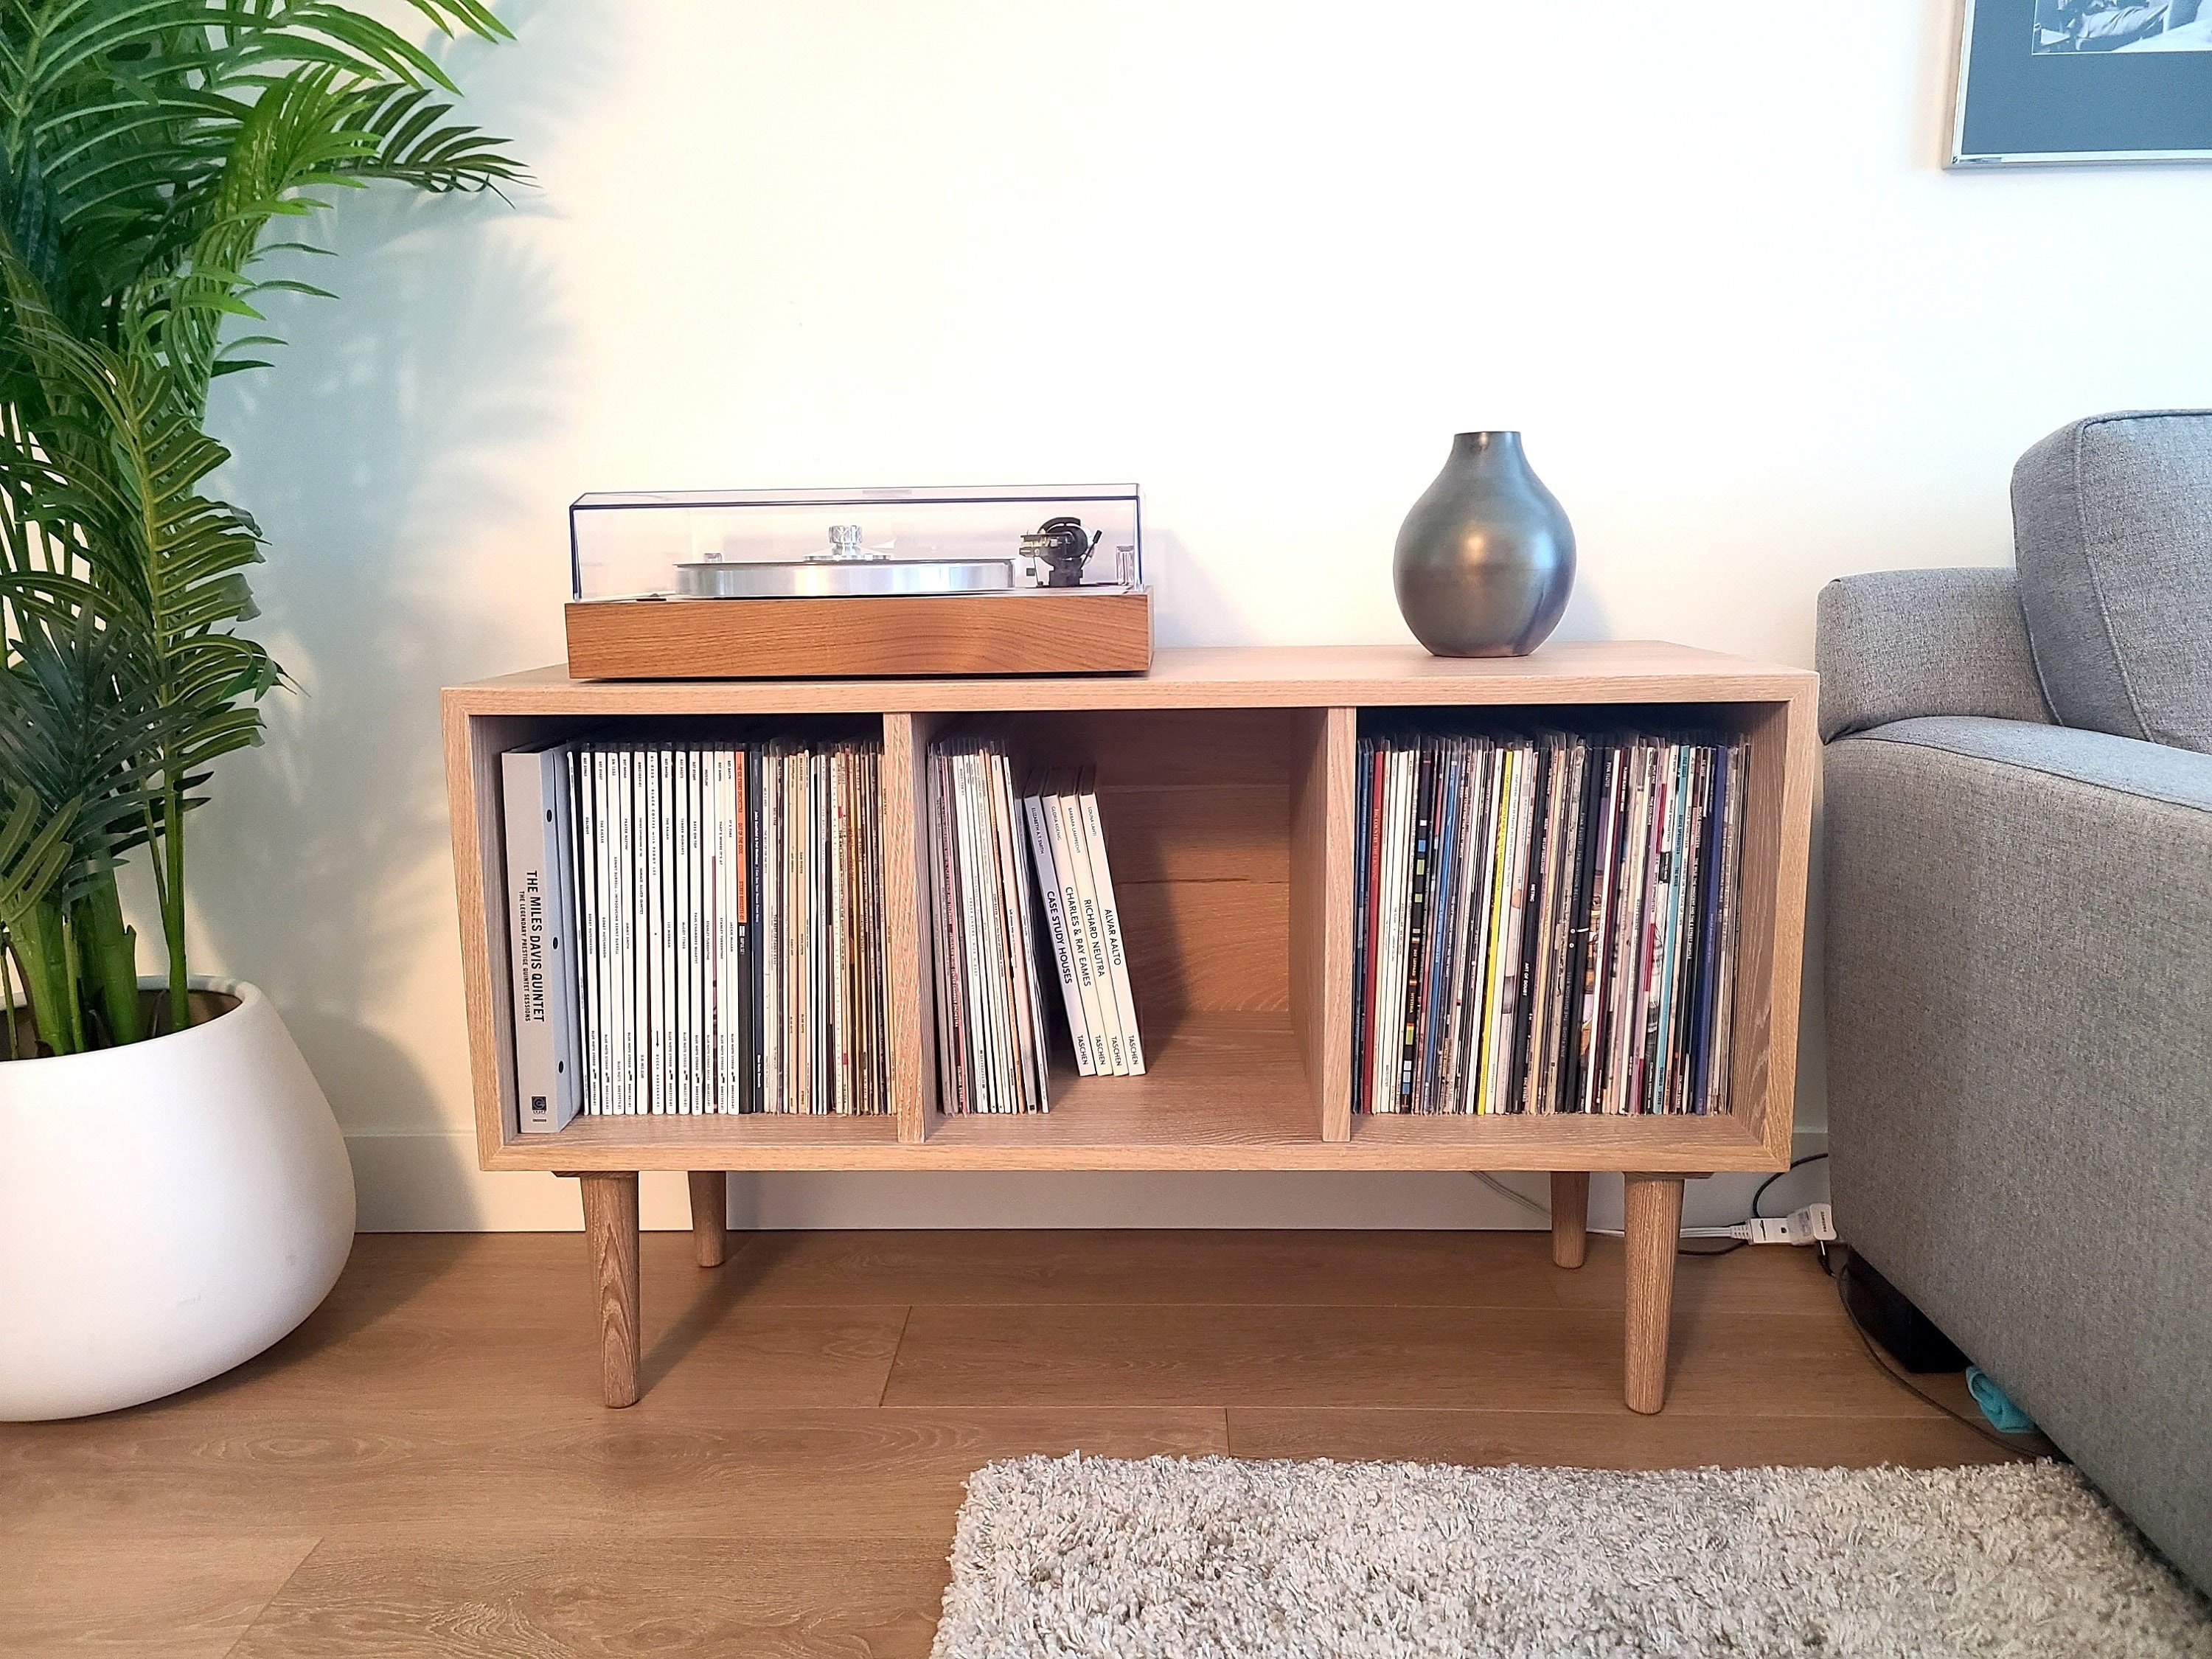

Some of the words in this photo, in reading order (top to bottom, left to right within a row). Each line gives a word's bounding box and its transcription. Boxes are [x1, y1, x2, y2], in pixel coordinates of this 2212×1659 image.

[1032, 807, 1040, 830] ELIZABETH
[1072, 827, 1080, 853] LAMPRECHT
[526, 871, 538, 893] THE
[529, 897, 543, 931] MILES
[1065, 887, 1079, 926] CHARLES
[1105, 909, 1116, 935] ALVAR
[1047, 891, 1057, 914] CASE
[1052, 916, 1064, 944] STUDY
[1059, 948, 1073, 984] HOUSES
[1076, 939, 1085, 954] RAY
[1084, 900, 1098, 939] RICHARD
[1092, 942, 1105, 977] NEUTRA
[1110, 938, 1121, 965] AALTO
[529, 936, 542, 970] DAVIS
[1079, 957, 1091, 986] EAMES
[531, 973, 544, 1022] QUINTET
[1077, 1035, 1088, 1065] TASCHEN
[1095, 1035, 1105, 1065] TASCHEN
[1111, 1036, 1122, 1066] TASCHEN
[1128, 1035, 1138, 1065] TASCHEN
